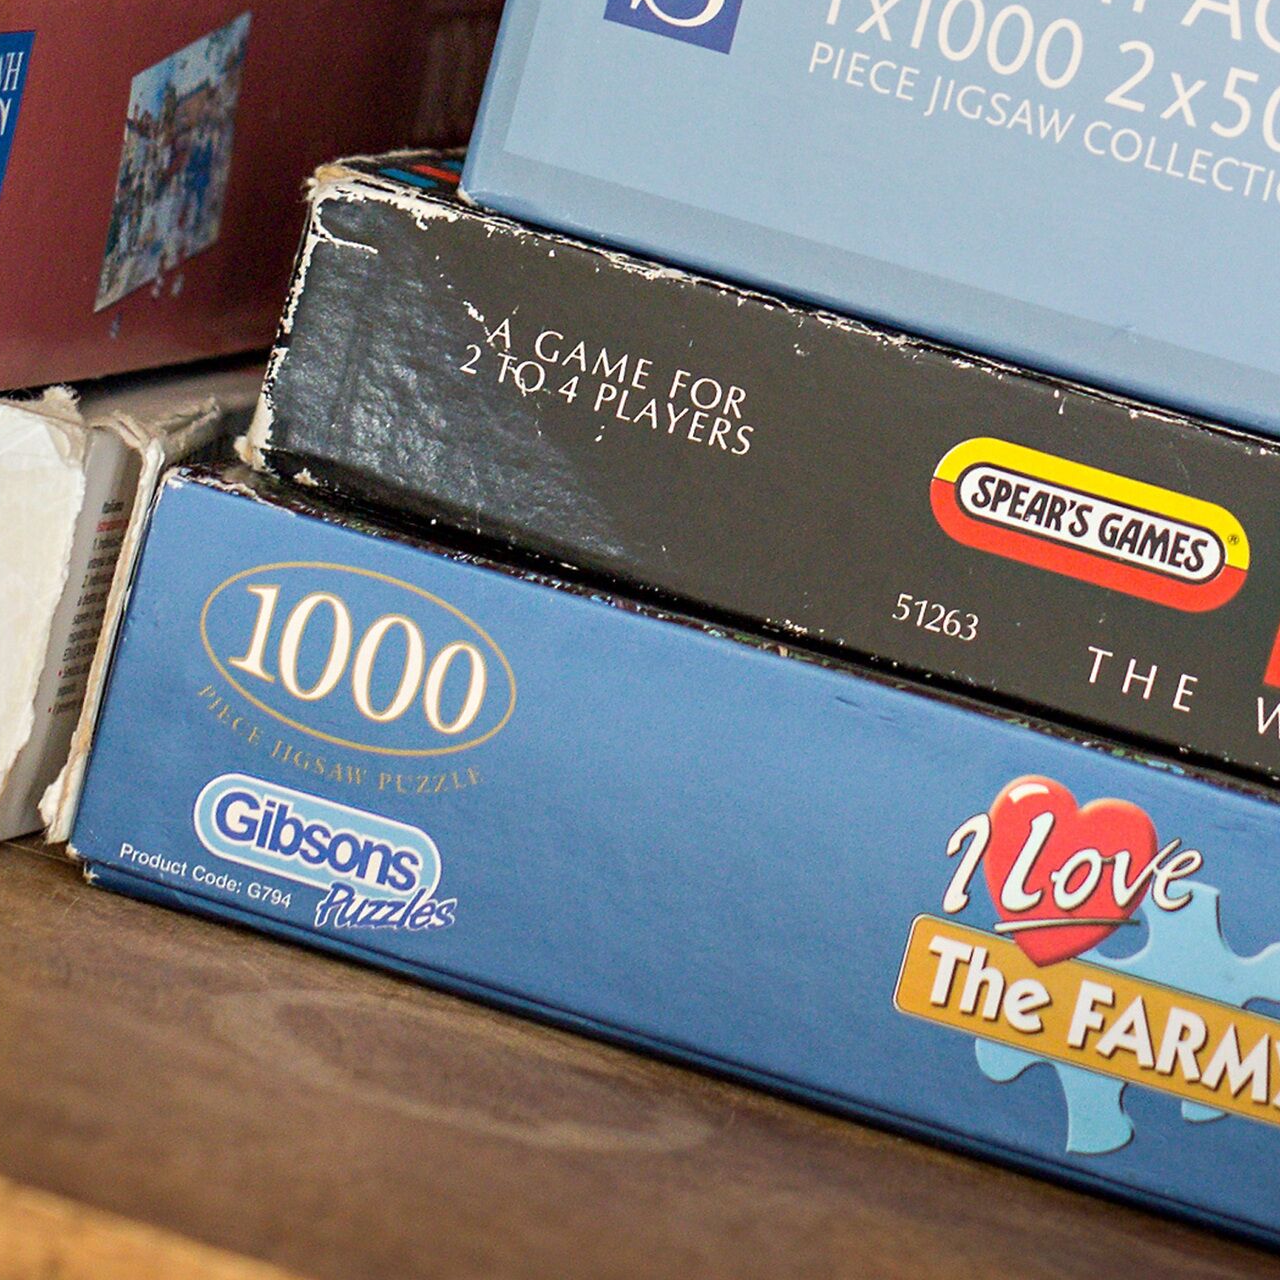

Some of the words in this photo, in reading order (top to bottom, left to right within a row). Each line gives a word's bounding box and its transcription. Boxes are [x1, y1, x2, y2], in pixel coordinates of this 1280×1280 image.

[808, 39, 920, 102] PIECE
[922, 73, 1077, 146] JIGSAW
[459, 343, 483, 376] 2
[497, 352, 548, 393] TO
[558, 375, 580, 404] 4
[593, 386, 755, 457] PLAYERS
[534, 330, 654, 391] GAME
[670, 368, 748, 420] FOR
[970, 473, 1095, 538] SPEAR'S
[1097, 513, 1209, 574] GAMES
[227, 582, 488, 735] 1000
[891, 592, 980, 642] 51263
[1087, 646, 1200, 713] THE
[198, 682, 261, 747] PIECE
[270, 737, 367, 787] JIGSAW
[377, 764, 486, 793] PUZZLE
[119, 841, 188, 878] Product
[192, 863, 242, 894] Code:
[246, 883, 293, 910] G794
[214, 789, 421, 891] Gibsons
[1000, 810, 1205, 912] Love
[313, 881, 458, 931] Puzzles
[927, 934, 1052, 1035] The
